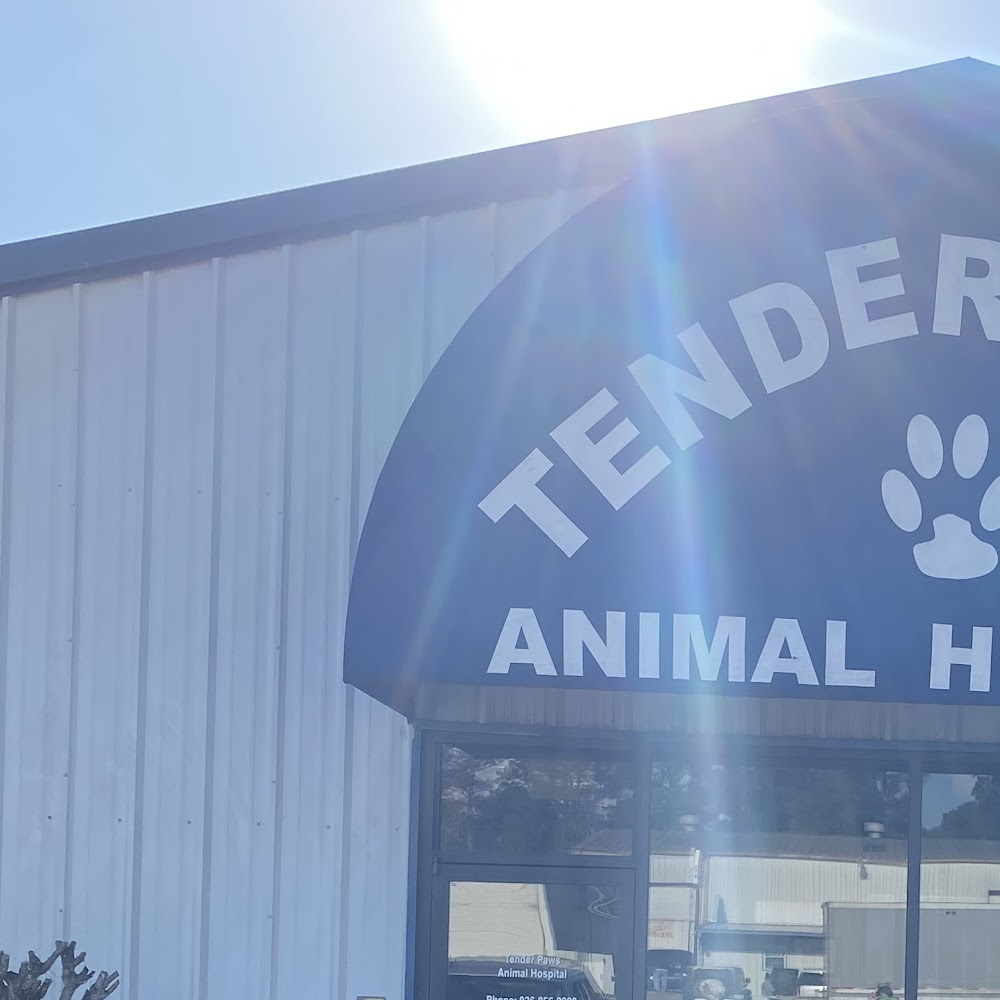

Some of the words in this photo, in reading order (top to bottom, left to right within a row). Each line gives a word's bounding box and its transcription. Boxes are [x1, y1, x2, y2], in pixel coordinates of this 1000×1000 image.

[486, 607, 876, 688] ANIMAL
[506, 955, 535, 964] Tender
[537, 955, 561, 965] Paws
[498, 968, 528, 978] Animal
[530, 969, 568, 980] Hospital
